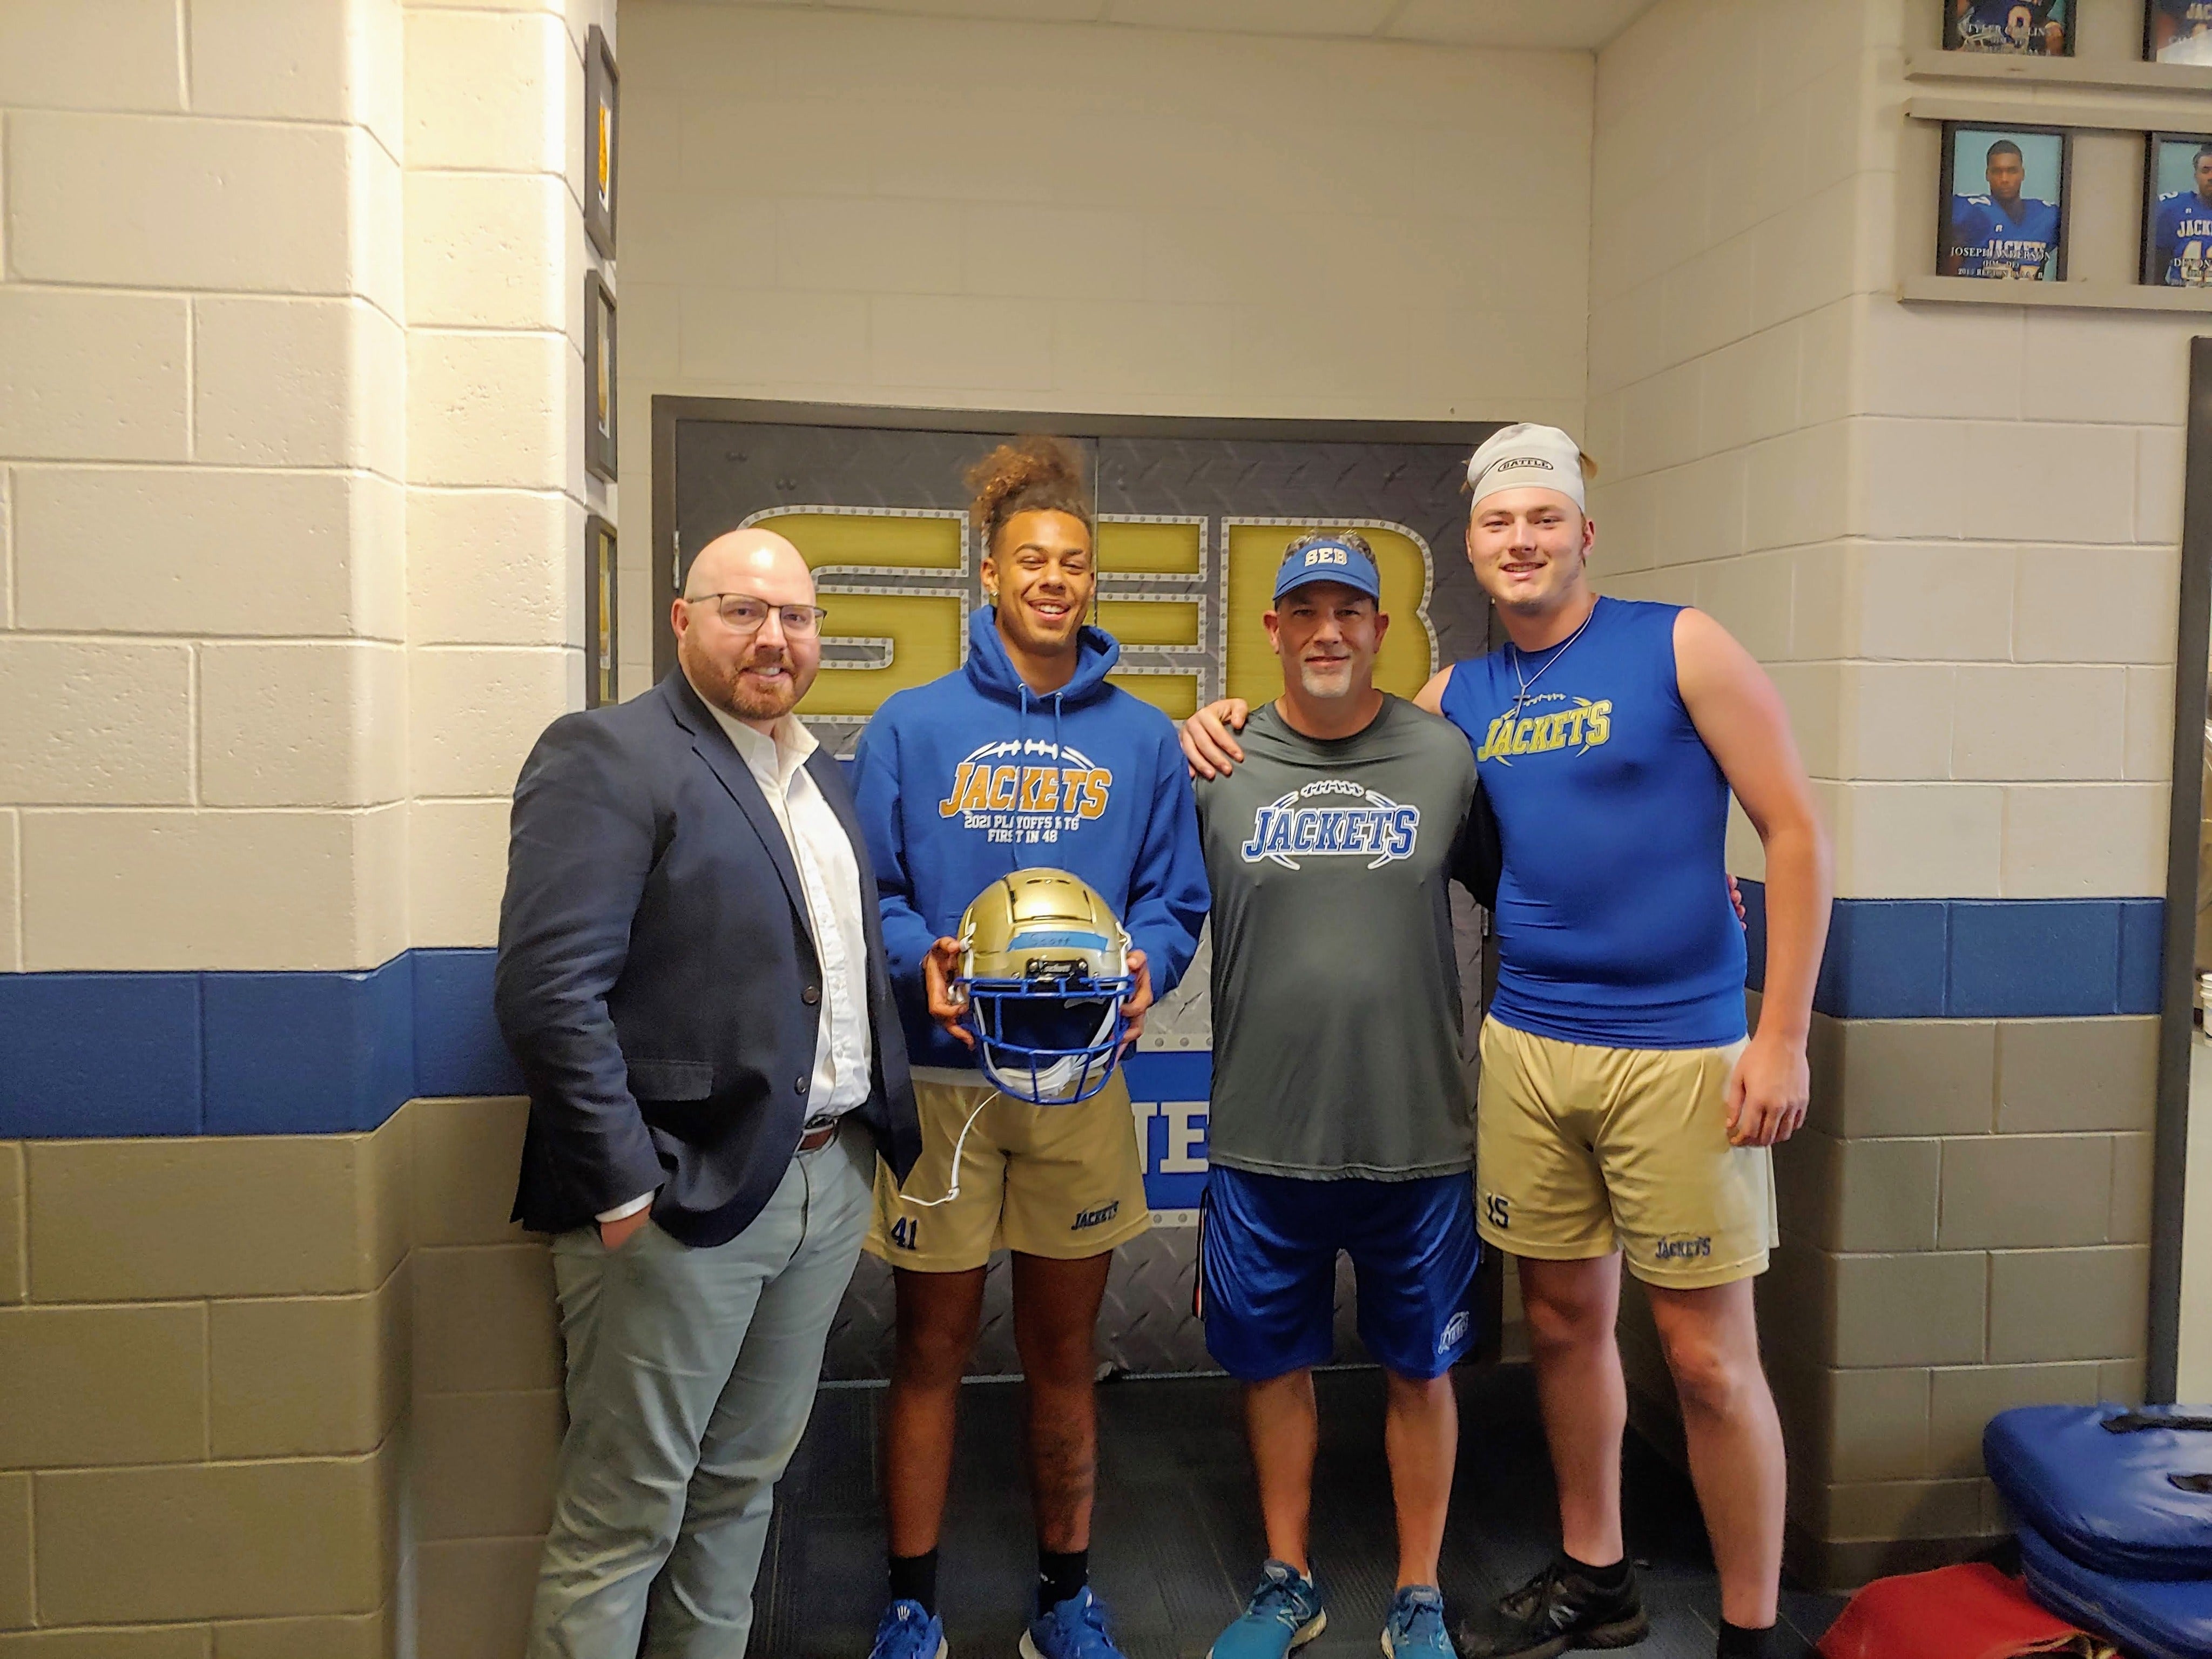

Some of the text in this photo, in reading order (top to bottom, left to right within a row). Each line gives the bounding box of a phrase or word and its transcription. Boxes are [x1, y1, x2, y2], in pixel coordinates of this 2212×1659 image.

[1503, 459, 1549, 469] BATTLE
[1304, 547, 1348, 567] SEB
[1476, 699, 1613, 761] JACKETS
[939, 762, 1112, 820] JACKETS
[965, 815, 991, 829] 2021
[1241, 805, 1420, 862] JACKETS
[987, 828, 1058, 844] FIRST IN 48
[1071, 1201, 1119, 1230] JACKETS
[891, 1216, 918, 1250] 41
[1655, 1236, 1711, 1258] JACKETS
